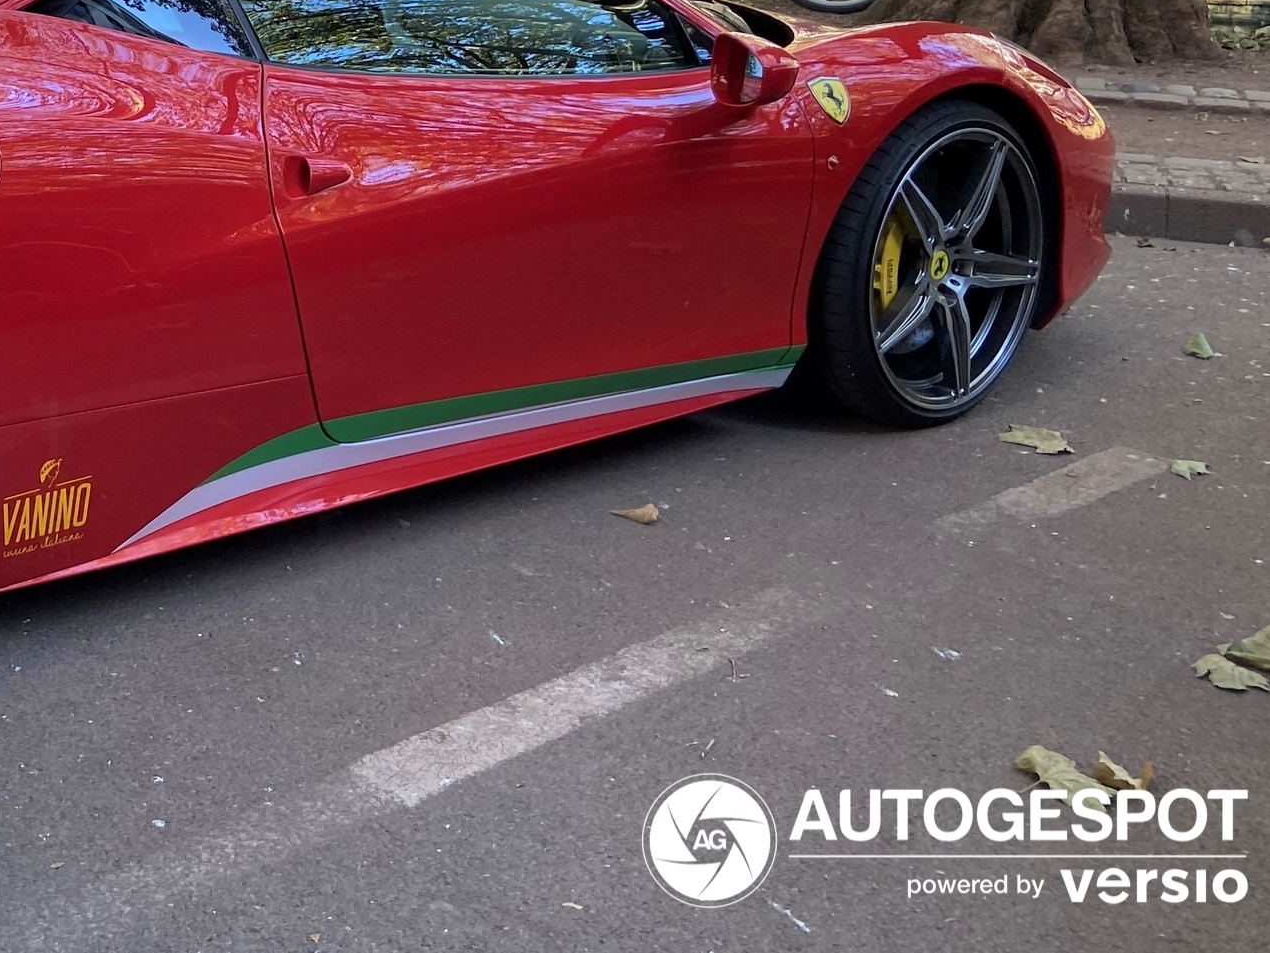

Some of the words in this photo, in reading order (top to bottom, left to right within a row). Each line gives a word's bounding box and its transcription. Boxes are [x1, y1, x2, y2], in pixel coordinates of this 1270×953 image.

[2, 482, 92, 546] VANINO
[2, 543, 39, 559] cucina
[40, 532, 85, 550] italiana
